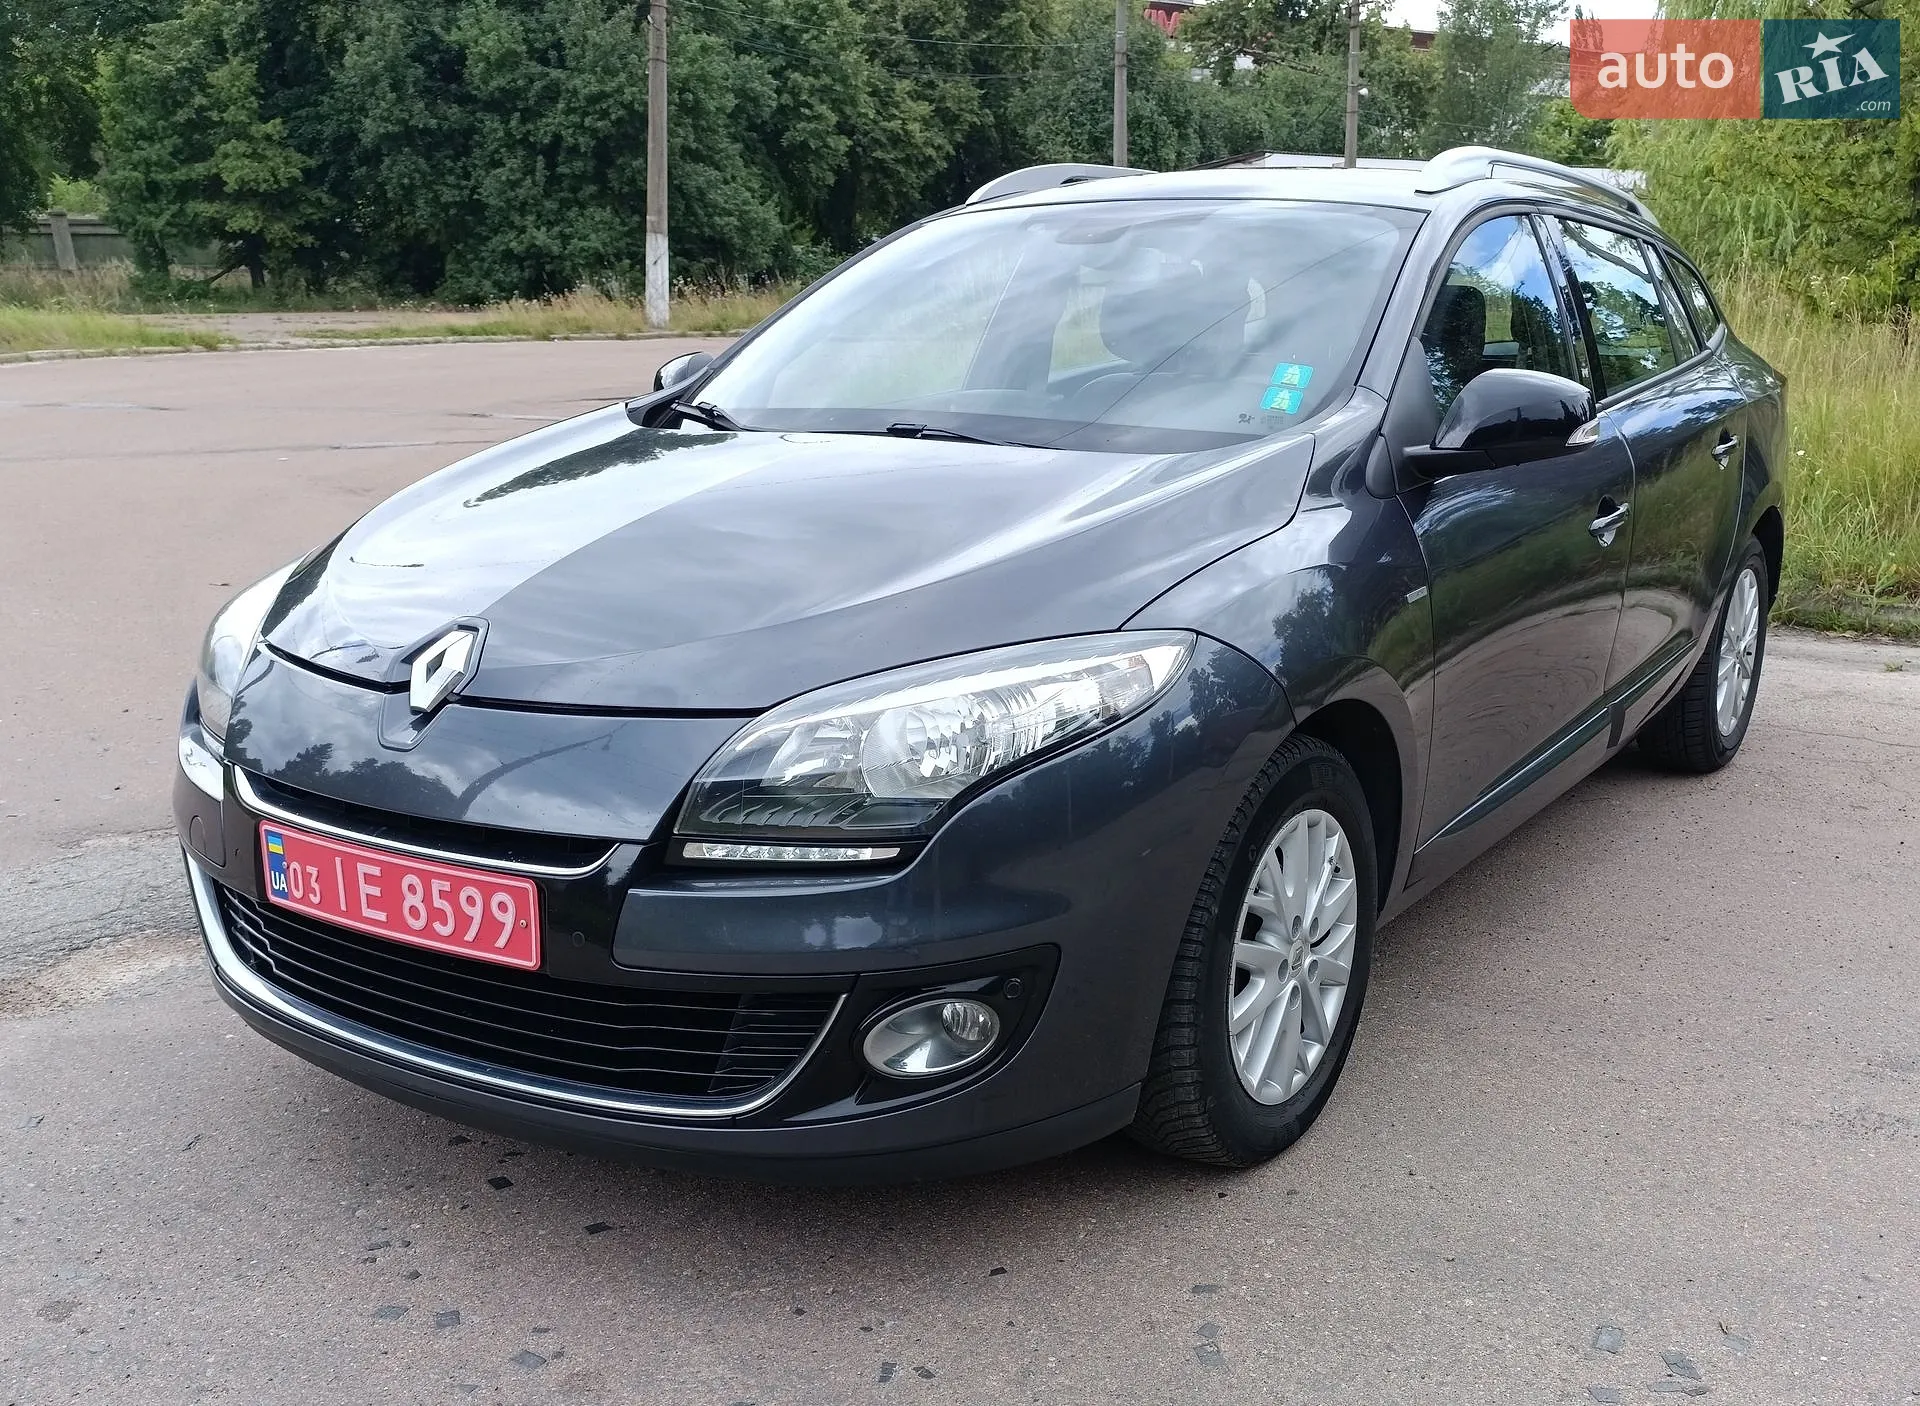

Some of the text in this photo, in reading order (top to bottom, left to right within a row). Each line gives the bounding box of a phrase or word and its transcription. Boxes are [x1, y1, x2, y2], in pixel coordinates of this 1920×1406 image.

[271, 870, 287, 893] UA
[289, 856, 516, 949] 03 IE 8599
